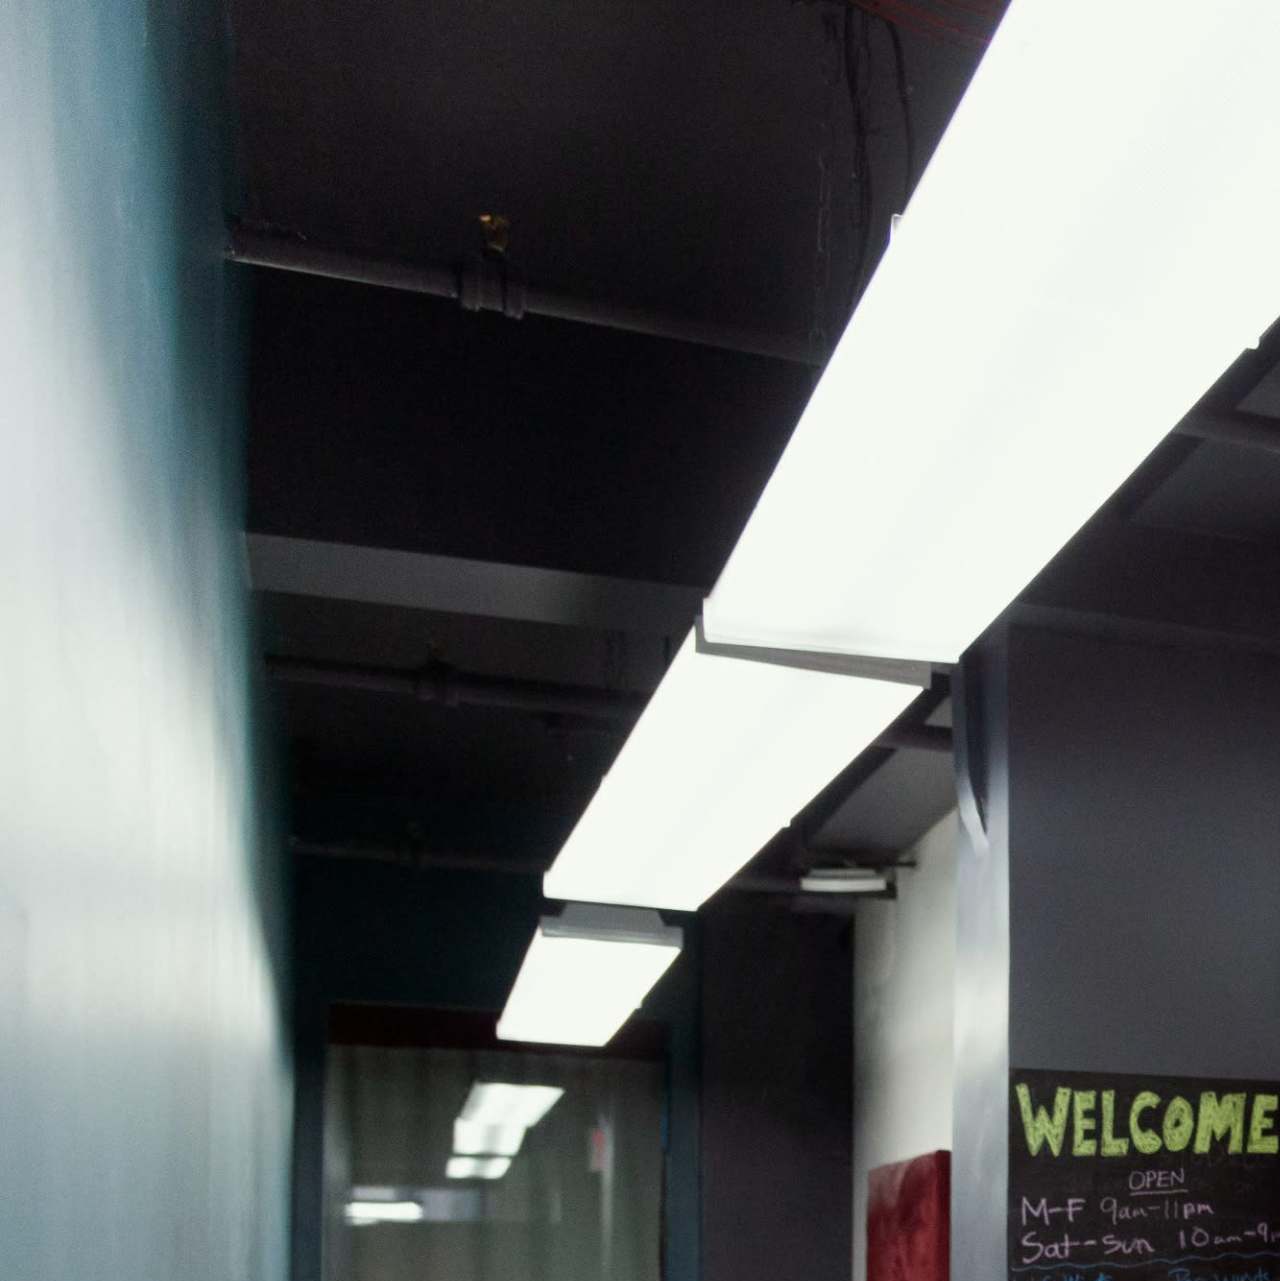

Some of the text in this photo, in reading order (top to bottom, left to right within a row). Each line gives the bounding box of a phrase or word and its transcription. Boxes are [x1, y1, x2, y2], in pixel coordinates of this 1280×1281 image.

[1015, 1082, 1279, 1157] WELCOME
[1129, 1168, 1185, 1189] OPEN
[1022, 1197, 1086, 1225] M-F
